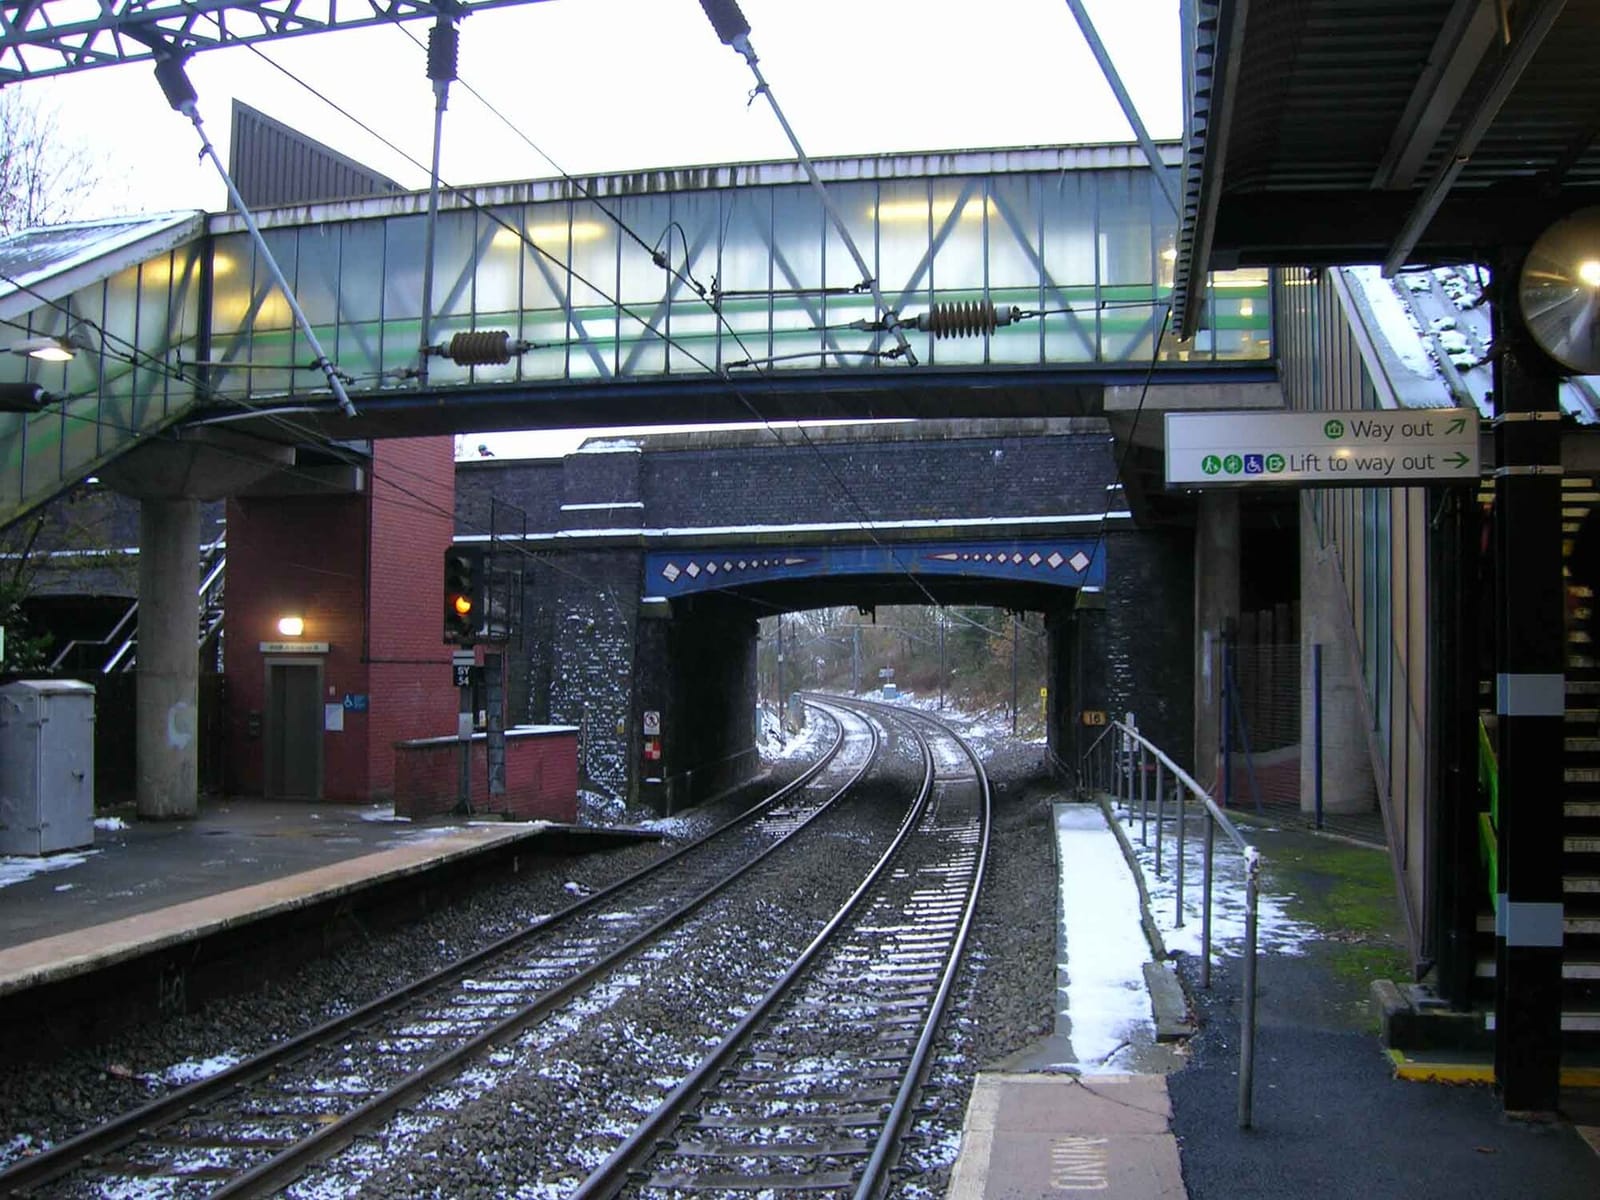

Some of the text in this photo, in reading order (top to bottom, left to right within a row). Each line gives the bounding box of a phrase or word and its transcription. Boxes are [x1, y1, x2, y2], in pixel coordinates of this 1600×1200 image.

[1351, 420, 1434, 442] Way out
[1290, 455, 1435, 476] Lift to way out
[1050, 1137, 1109, 1190] MIND
